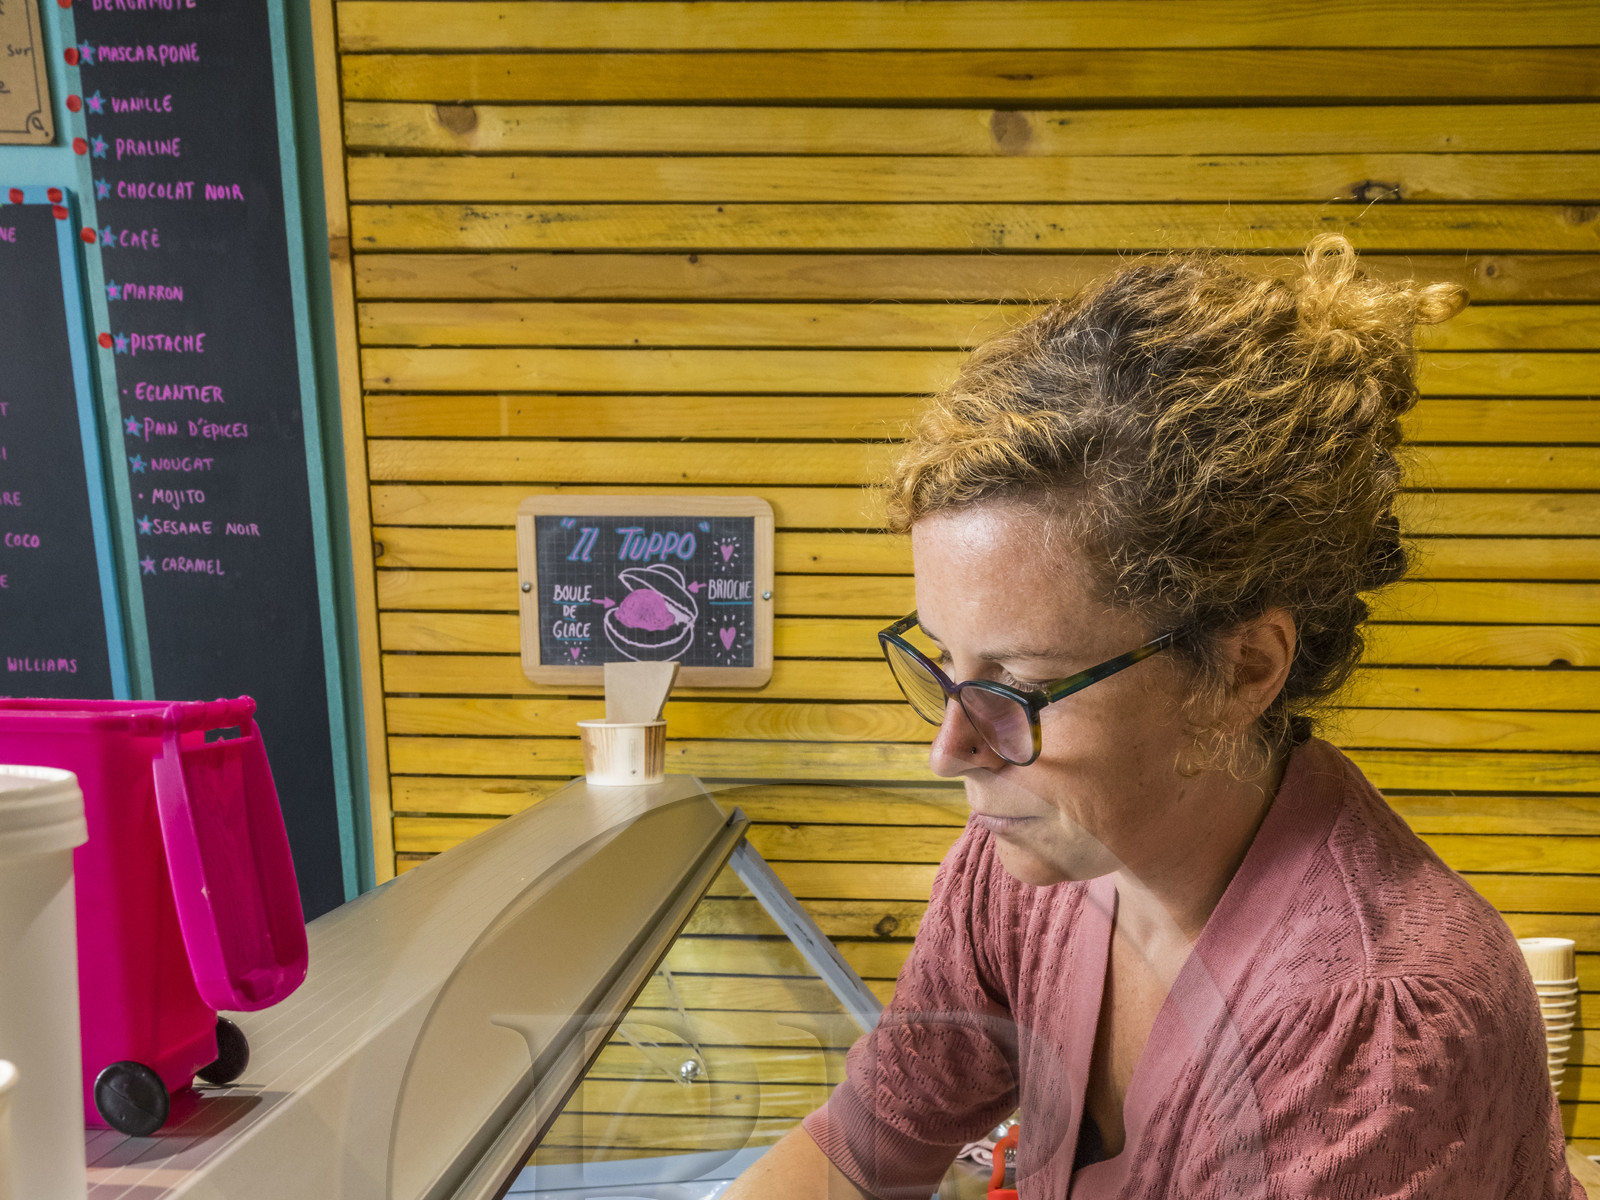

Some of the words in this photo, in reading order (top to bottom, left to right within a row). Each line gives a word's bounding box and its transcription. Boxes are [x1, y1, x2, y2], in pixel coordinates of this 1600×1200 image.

[98, 42, 200, 67] MASCARPONE
[111, 94, 173, 113] VANILLE
[115, 137, 181, 161] PRALINE
[117, 180, 195, 200] CHOCOLAT
[204, 183, 245, 201] NOIR
[123, 282, 184, 302] MARRON
[131, 333, 207, 356] PISTACHE
[135, 381, 225, 403] EGLANTIER
[144, 417, 179, 443] PAIN
[151, 457, 214, 472] NOUGAT
[152, 488, 206, 511] MOJITO
[152, 518, 212, 535] SESAME
[225, 522, 260, 537] NOIR
[5, 531, 41, 549] COCO
[162, 556, 225, 575] CARAMEL
[553, 584, 592, 602] BOULE
[708, 579, 752, 600] BRIOCHE
[562, 604, 577, 619] DE
[552, 620, 591, 638] GLACE
[7, 656, 78, 674] WILLIAMS
